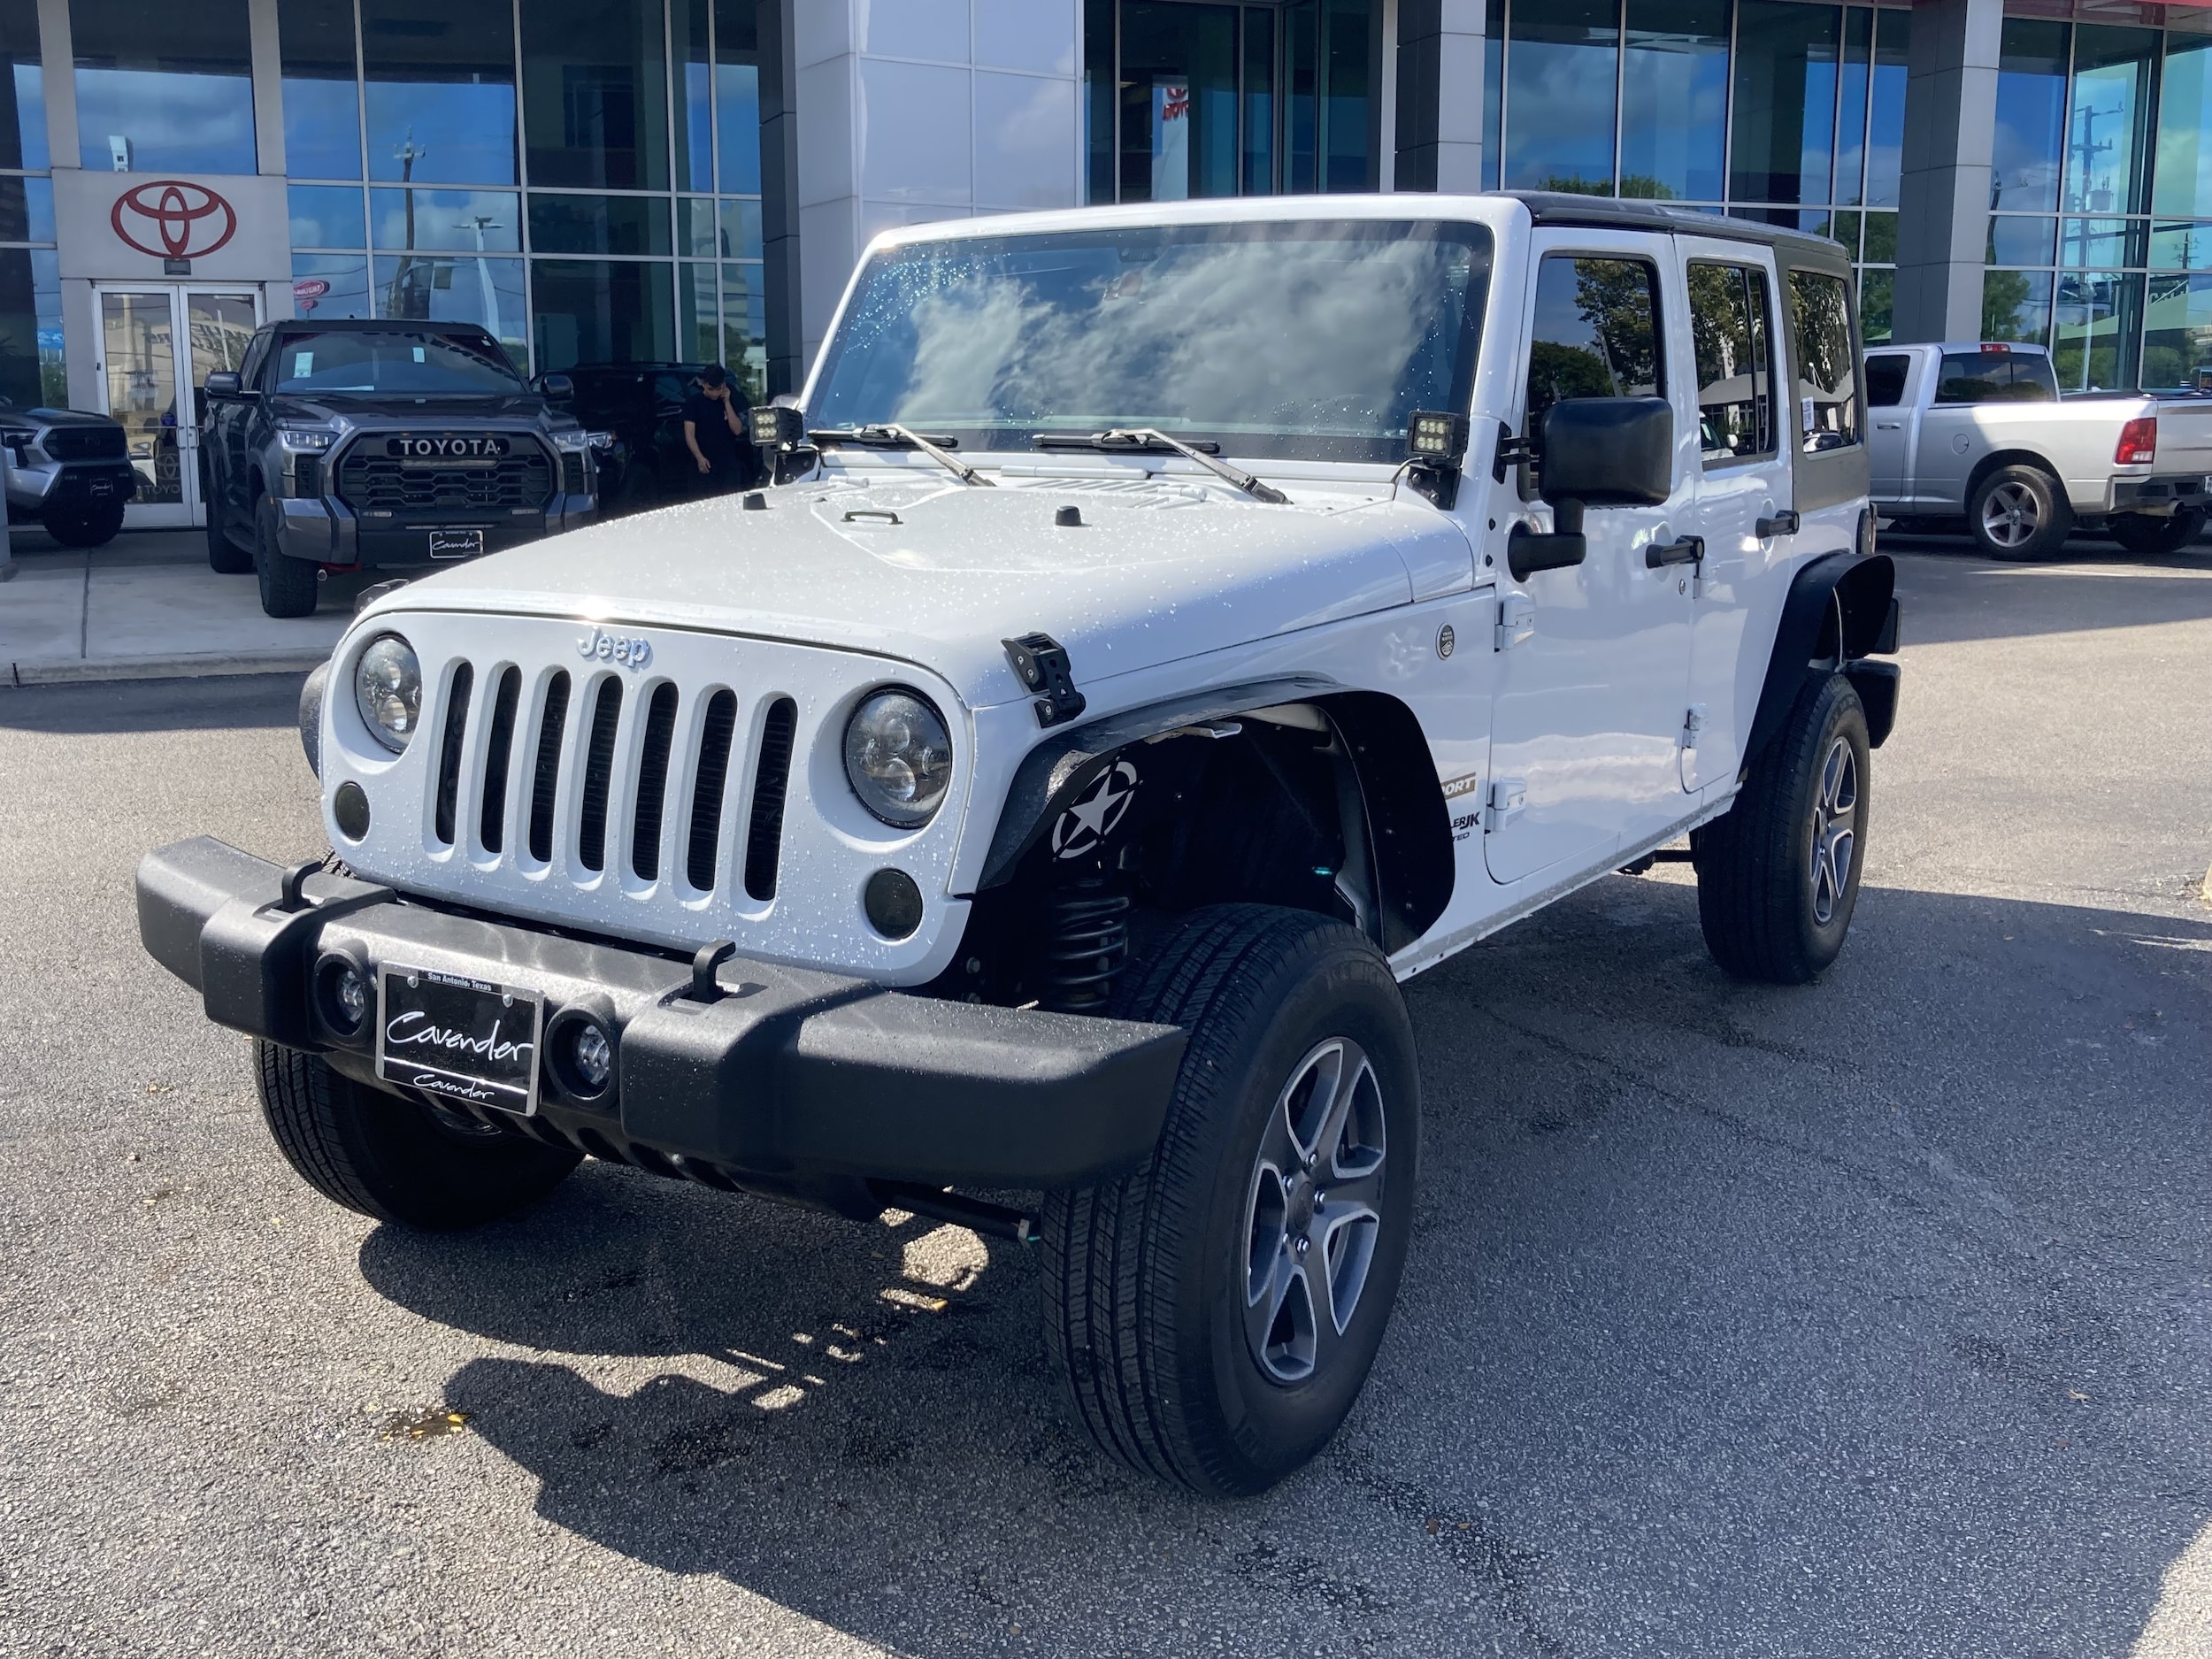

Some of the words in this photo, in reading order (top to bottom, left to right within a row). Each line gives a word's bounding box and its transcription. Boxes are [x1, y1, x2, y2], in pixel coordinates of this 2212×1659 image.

[399, 440, 498, 455] TOYOTA
[578, 626, 650, 668] Jeep
[427, 972, 442, 982] San
[442, 975, 470, 987] Antonio,
[472, 980, 492, 991] Texas
[387, 1011, 534, 1061] Cavender
[413, 1074, 495, 1099] Cavender
